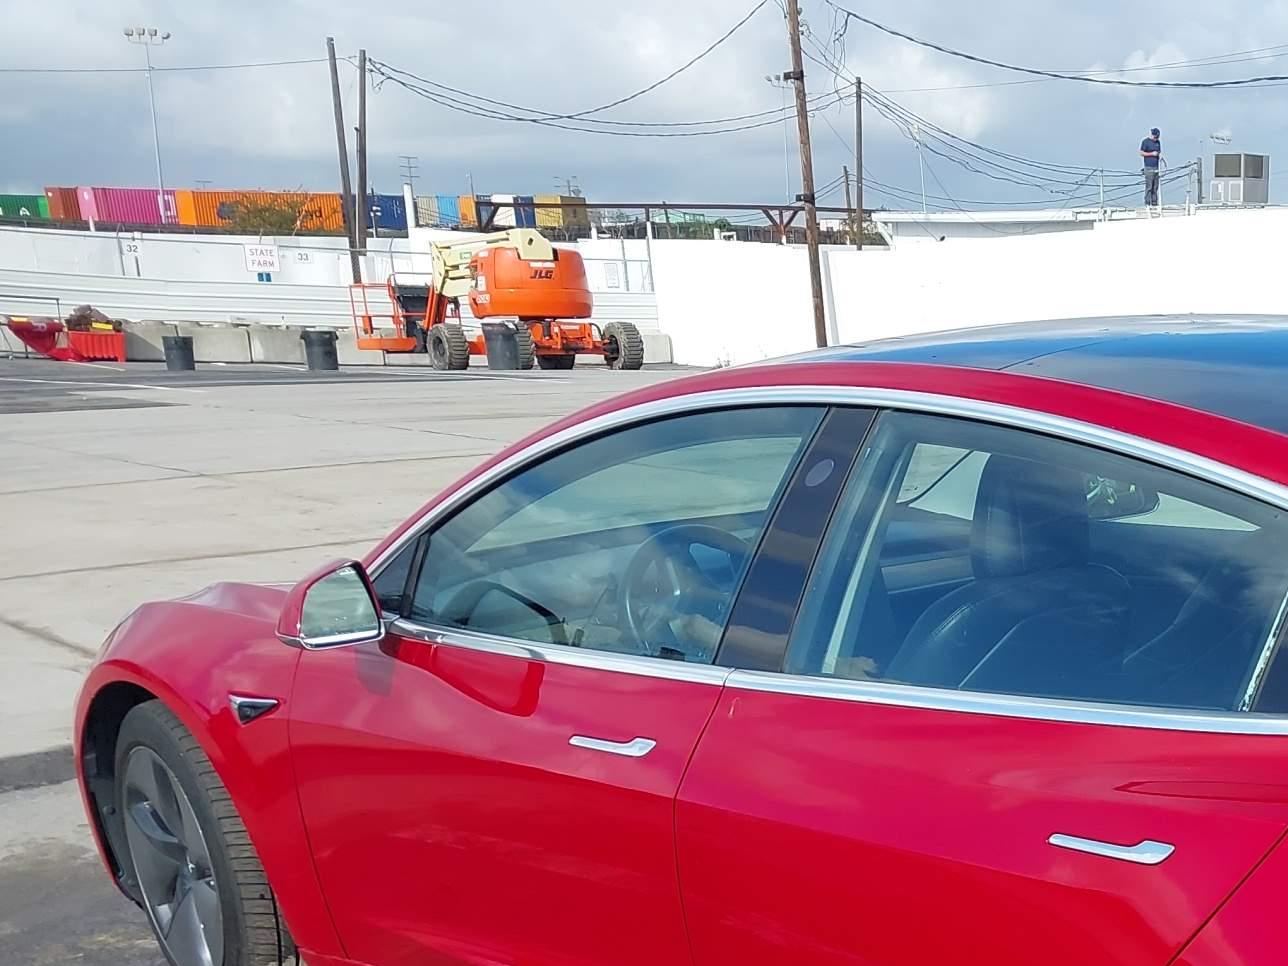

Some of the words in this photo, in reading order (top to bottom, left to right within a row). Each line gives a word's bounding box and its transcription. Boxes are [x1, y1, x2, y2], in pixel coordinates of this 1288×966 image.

[126, 244, 138, 253] 32
[249, 248, 274, 257] STATE
[297, 252, 309, 261] 33
[251, 259, 275, 268] FARM
[529, 269, 554, 280] JLG
